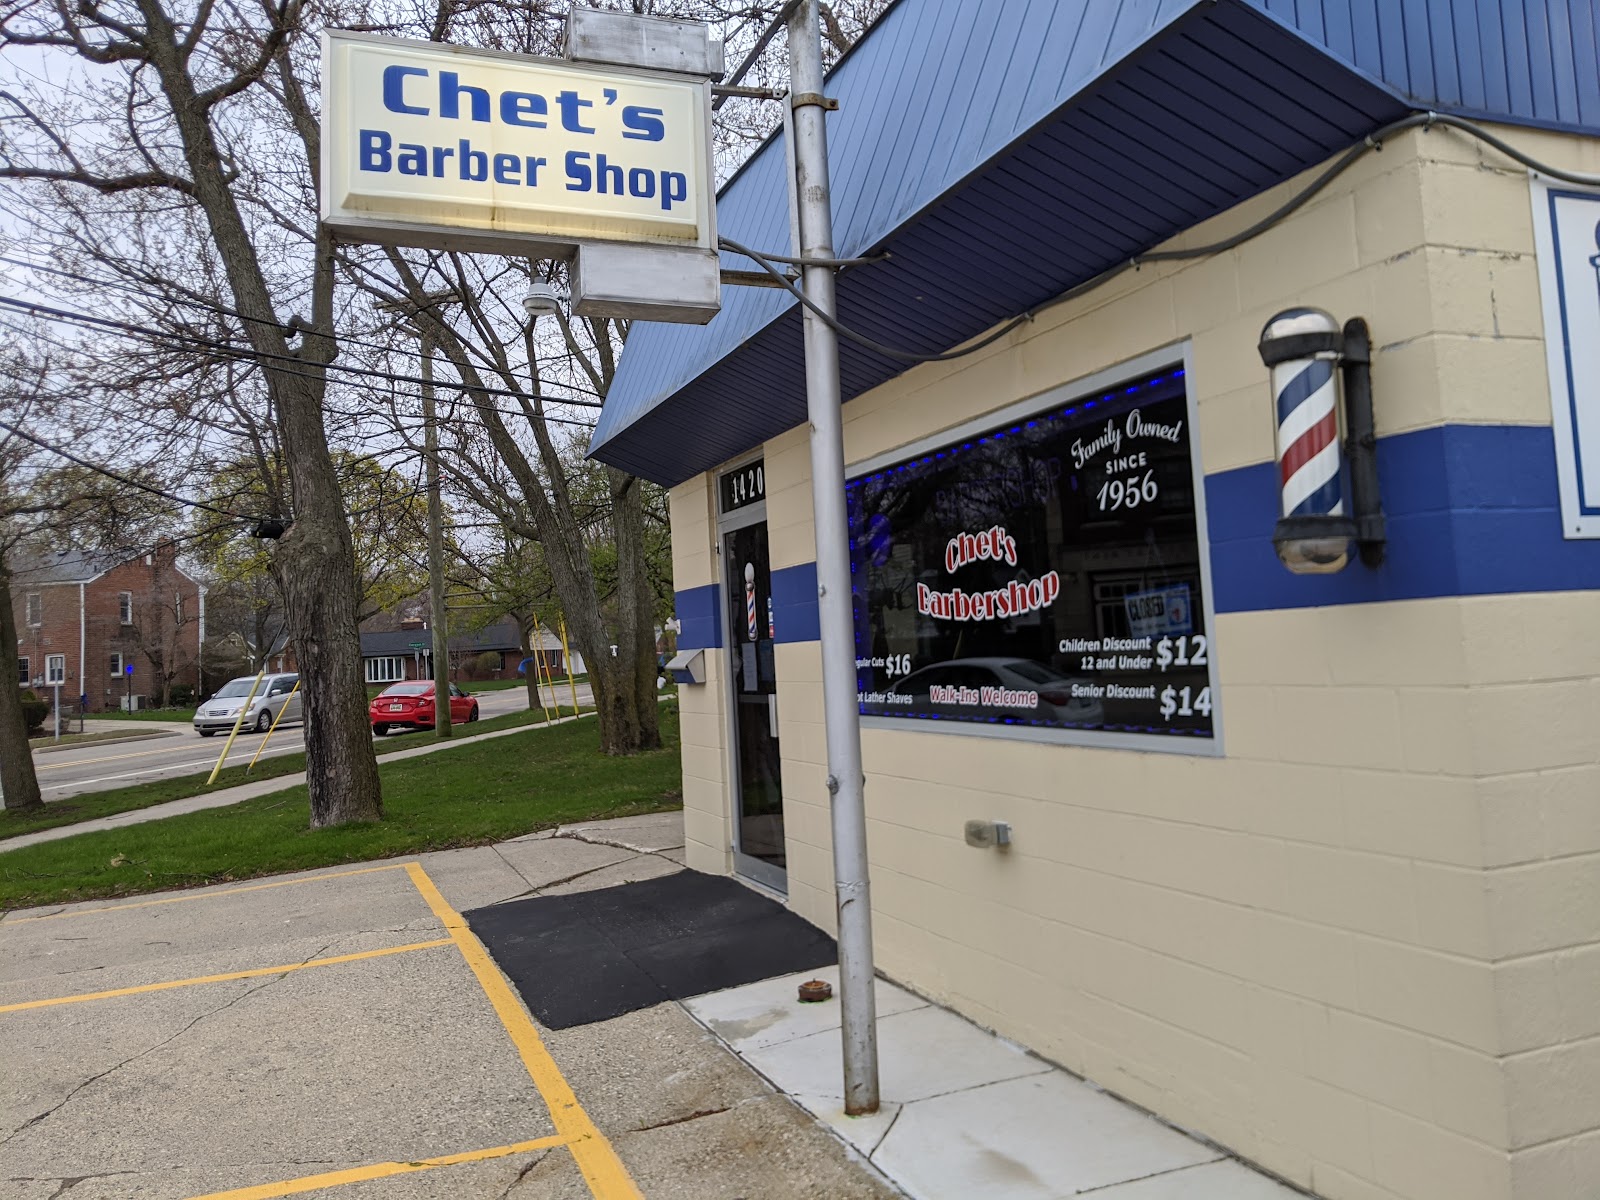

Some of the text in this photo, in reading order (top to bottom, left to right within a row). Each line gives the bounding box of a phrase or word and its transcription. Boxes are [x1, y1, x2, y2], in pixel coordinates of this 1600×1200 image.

[383, 65, 665, 142] Chet's
[359, 129, 687, 210] Barber Shop
[1071, 408, 1182, 469] Family Owned
[1105, 451, 1147, 474] SINCE
[732, 466, 763, 504] 1420
[1096, 469, 1158, 511] 1956
[945, 525, 1017, 574] Chet's
[917, 570, 1060, 621] Barbershop
[871, 656, 885, 667] Cuts
[885, 653, 911, 679] $16
[1059, 634, 1207, 672] Children Discount $12
[1080, 655, 1153, 670] 12 and Under
[864, 691, 887, 703] Lather
[886, 691, 914, 705] Shaves
[930, 685, 1038, 708] Walk-Ins Welcome
[1071, 683, 1212, 721] Senior Discount $14
